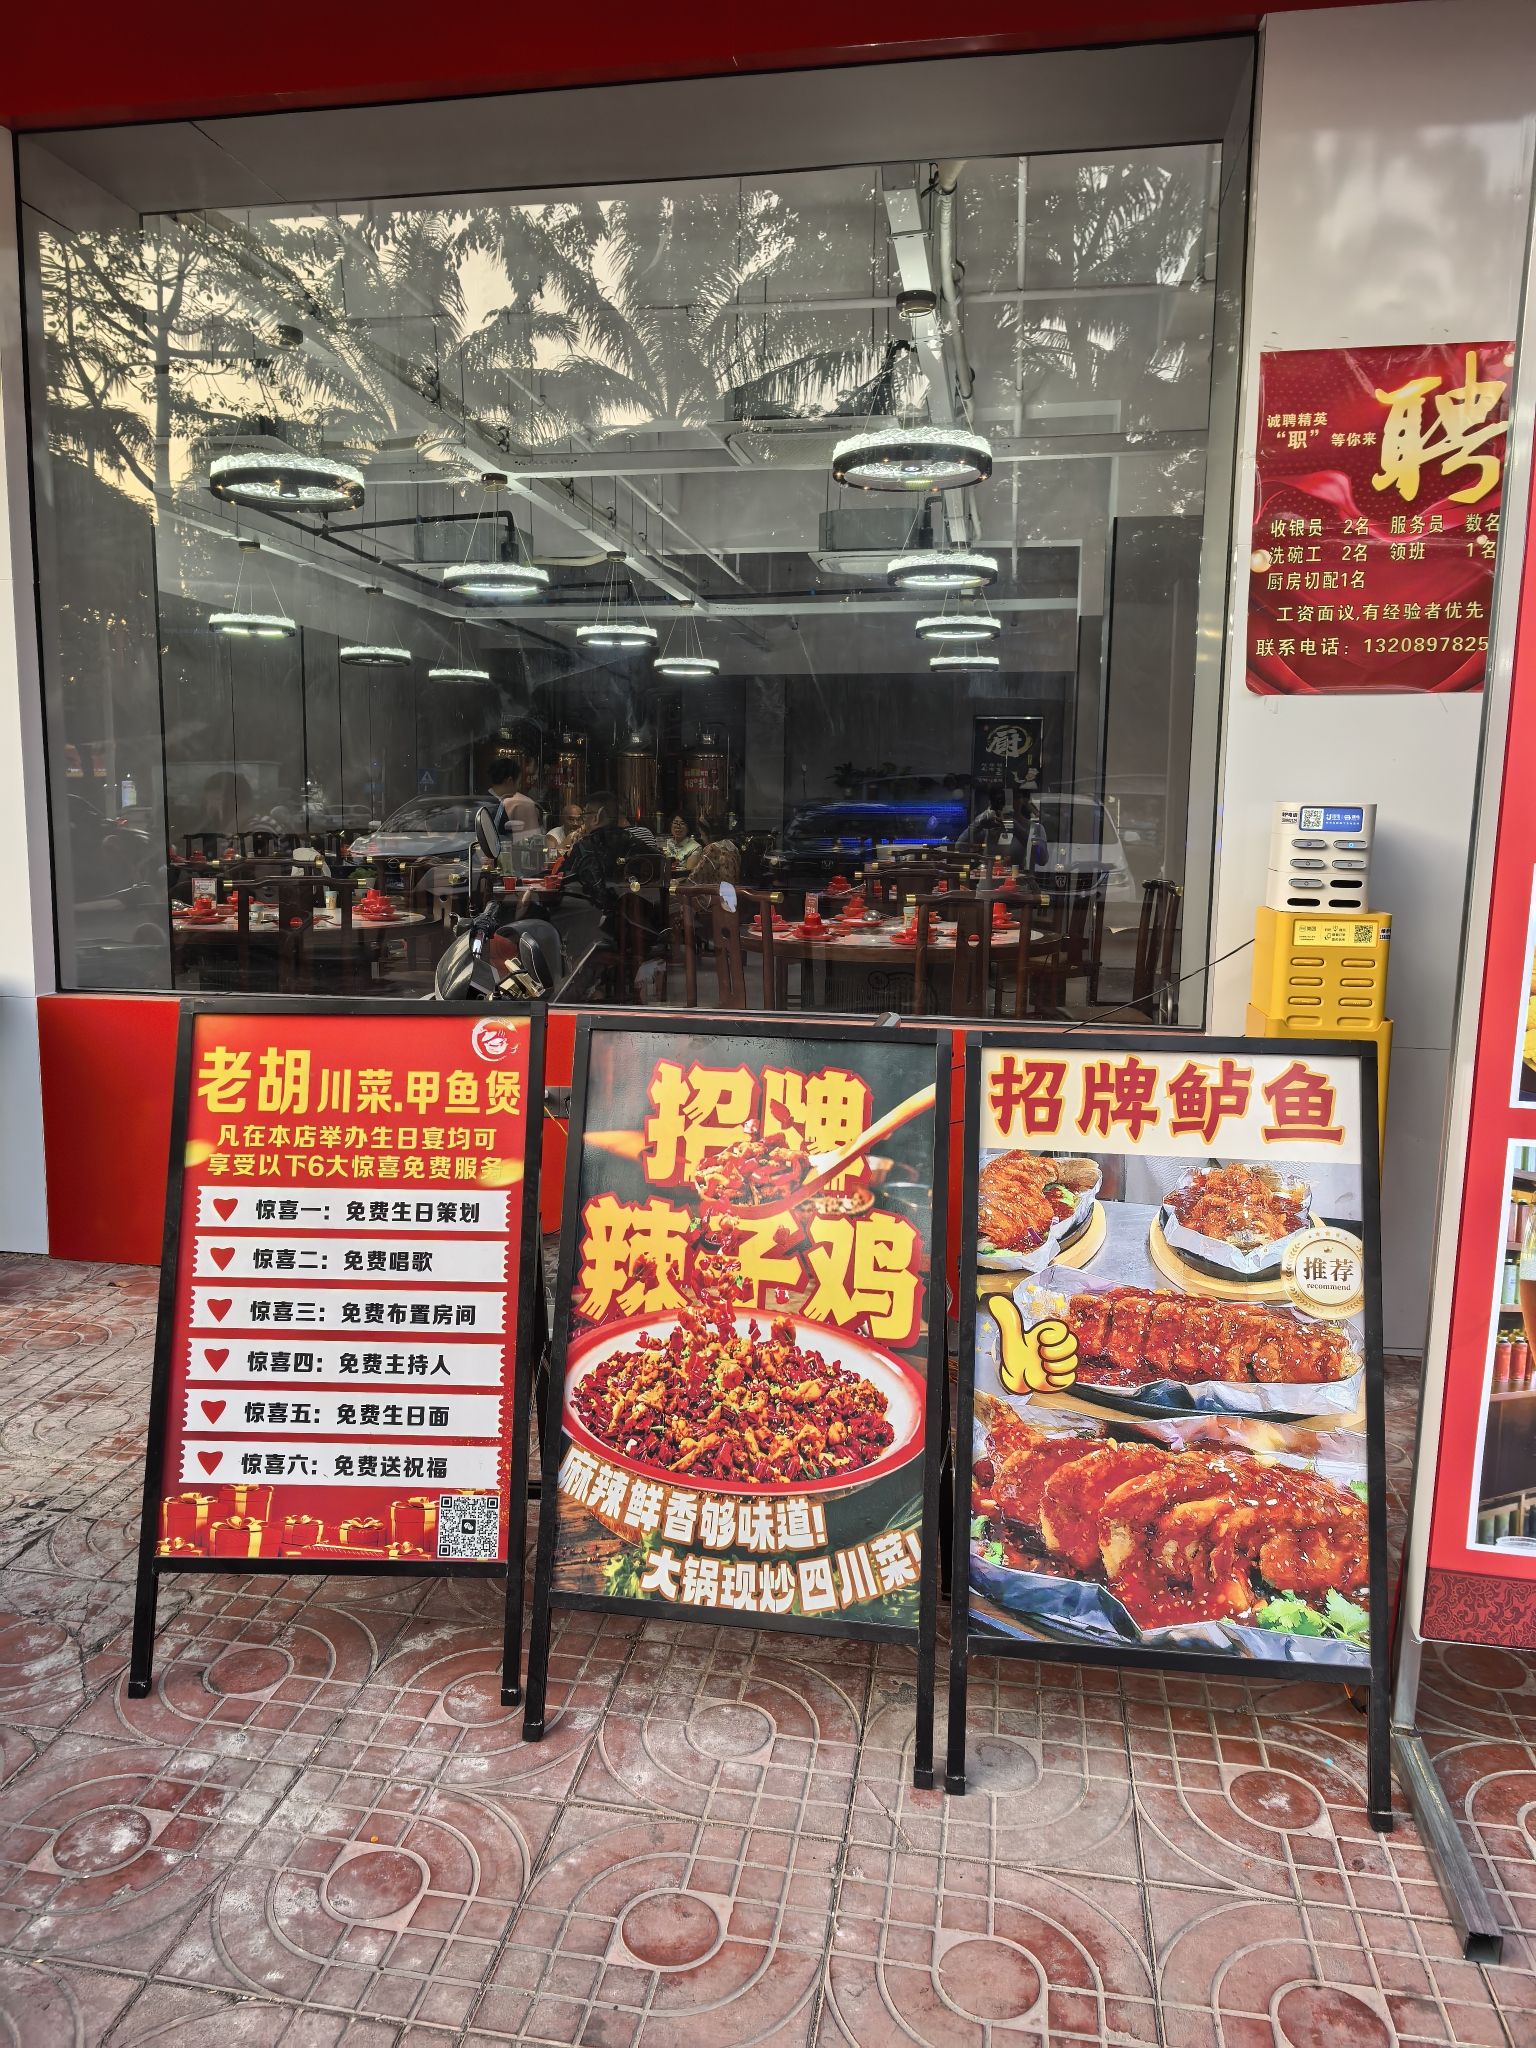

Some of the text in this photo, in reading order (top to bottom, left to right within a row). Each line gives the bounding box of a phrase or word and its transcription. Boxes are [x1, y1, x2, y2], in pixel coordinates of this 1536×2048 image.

[1267, 412, 1328, 429] 诚聘精英
[1371, 351, 1510, 503] 聘
[1331, 432, 1377, 447] 等你来
[1271, 512, 1500, 538] 收银员 2名 服务员 数名
[1268, 546, 1323, 565] 洗碗工
[1342, 544, 1369, 563] 2名
[1390, 542, 1426, 560] 领班
[1267, 571, 1366, 591] 厨房切配1名
[988, 1054, 1346, 1146] 招牌鲈鱼
[217, 1123, 497, 1151] 凡在本店举办生日宴均可
[645, 1060, 870, 1194] 招牌
[207, 1153, 503, 1180] 享受以下6大惊喜免费服务
[578, 1196, 919, 1342] 辣子鸡
[1303, 1256, 1354, 1282] 推荐
[1307, 1282, 1351, 1291] recommend
